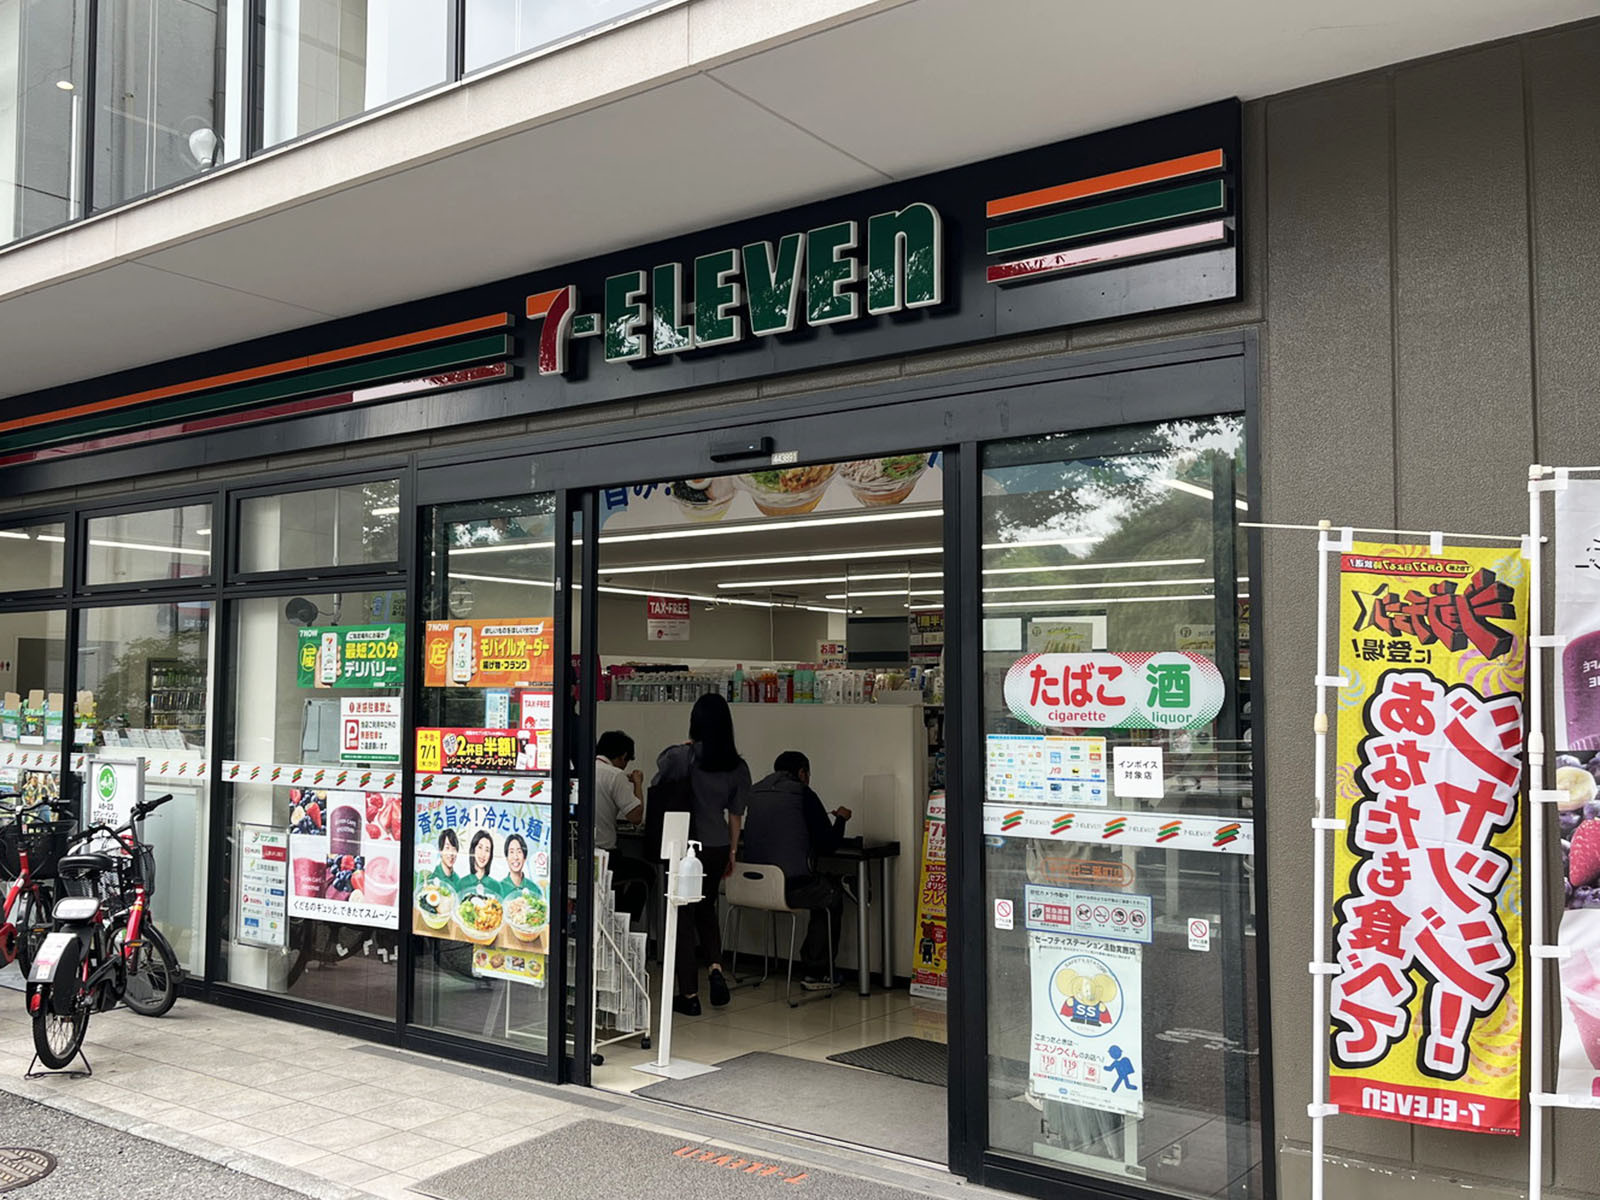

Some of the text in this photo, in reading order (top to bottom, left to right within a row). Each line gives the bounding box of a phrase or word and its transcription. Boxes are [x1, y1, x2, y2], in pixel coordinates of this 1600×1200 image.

[345, 641, 399, 659] 最短20分
[480, 637, 549, 657] モバイルオーダー
[344, 660, 397, 677] デリバリー
[1030, 662, 1191, 709] たばこ 酒
[1048, 710, 1193, 725] cigarette liquor
[420, 745, 437, 760] 7/1
[1119, 760, 1158, 769] インボイス
[1125, 771, 1152, 780] 対象店
[1076, 1004, 1097, 1017] SS
[1041, 1055, 1077, 1069] 110 119
